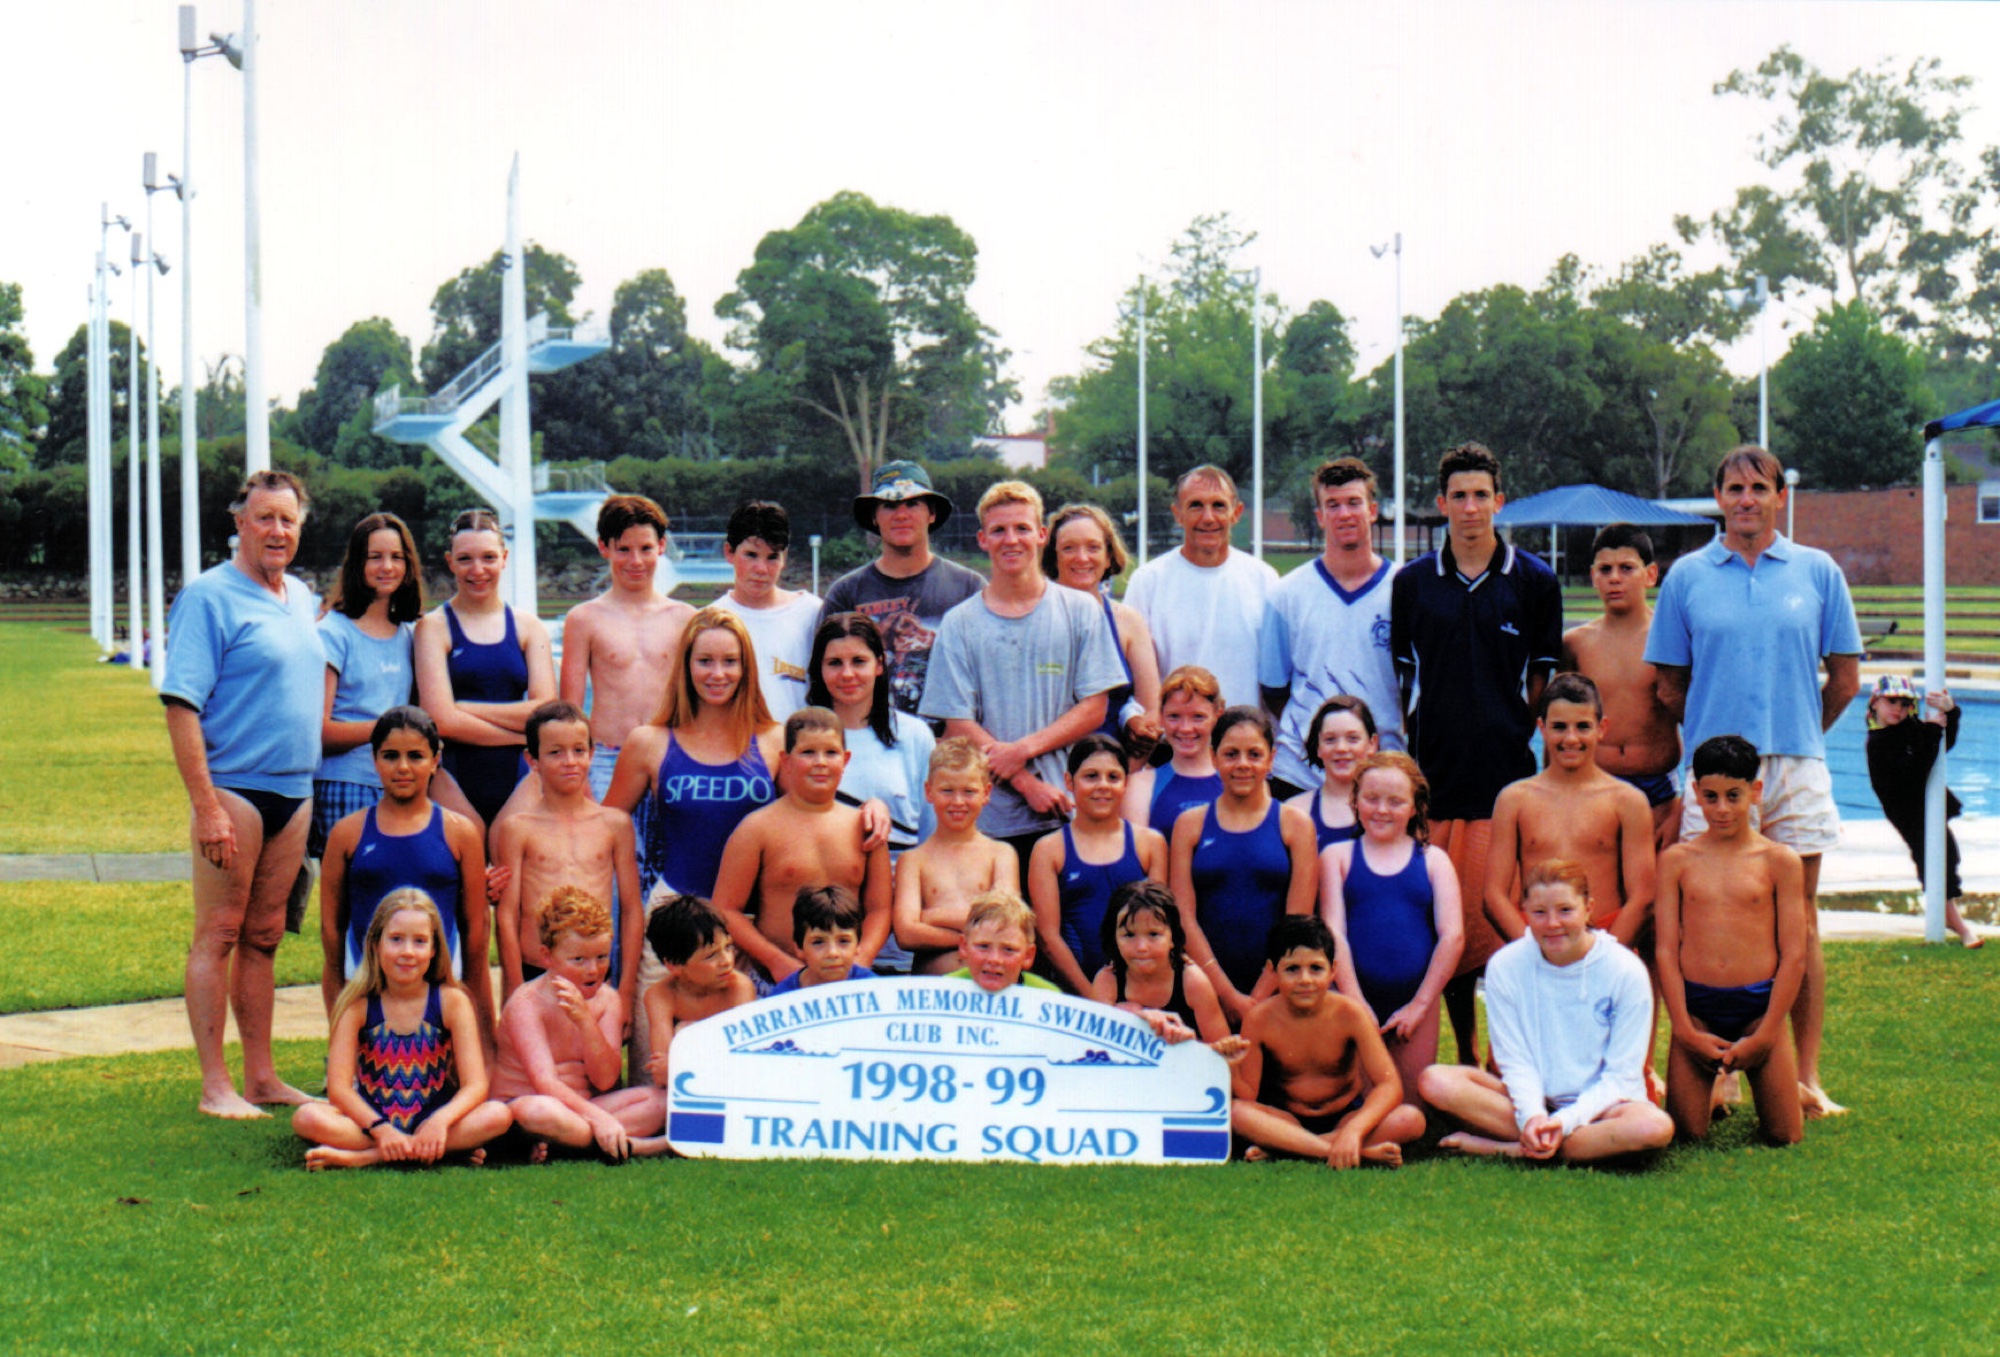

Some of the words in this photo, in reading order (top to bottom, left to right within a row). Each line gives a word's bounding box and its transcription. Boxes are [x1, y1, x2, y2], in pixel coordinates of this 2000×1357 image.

[665, 775, 771, 803] SPEEDO
[722, 991, 880, 1045] PARRAMATTA
[897, 989, 1023, 1018] MEMORIAL
[1038, 1002, 1167, 1060] SWIMMING
[886, 1022, 942, 1043] CLUB
[957, 1025, 999, 1046] INC.
[744, 1115, 957, 1153] TRAINING
[981, 1125, 1139, 1163] SQUAD
